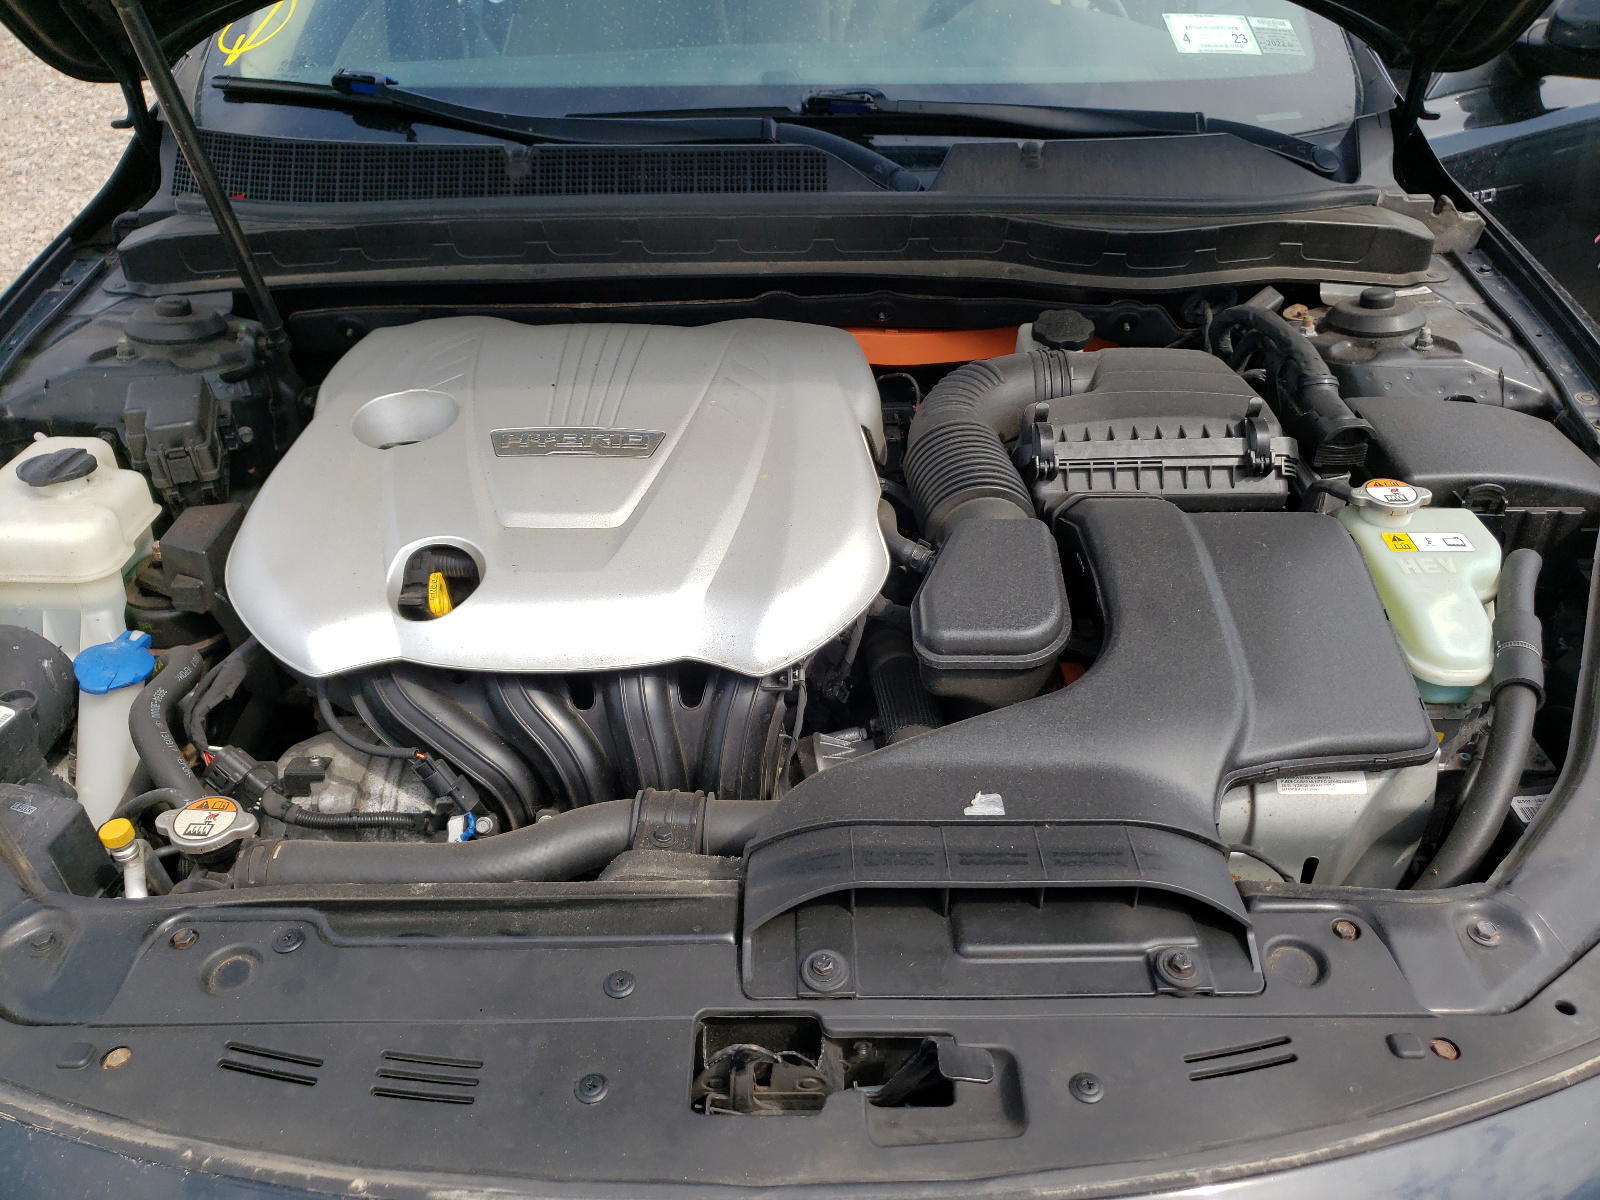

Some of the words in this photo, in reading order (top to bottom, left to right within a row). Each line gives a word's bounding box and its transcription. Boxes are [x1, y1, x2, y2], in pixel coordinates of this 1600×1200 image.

[1183, 33, 1191, 43] 4
[1231, 33, 1249, 44] 23
[1395, 556, 1457, 575] HEV
